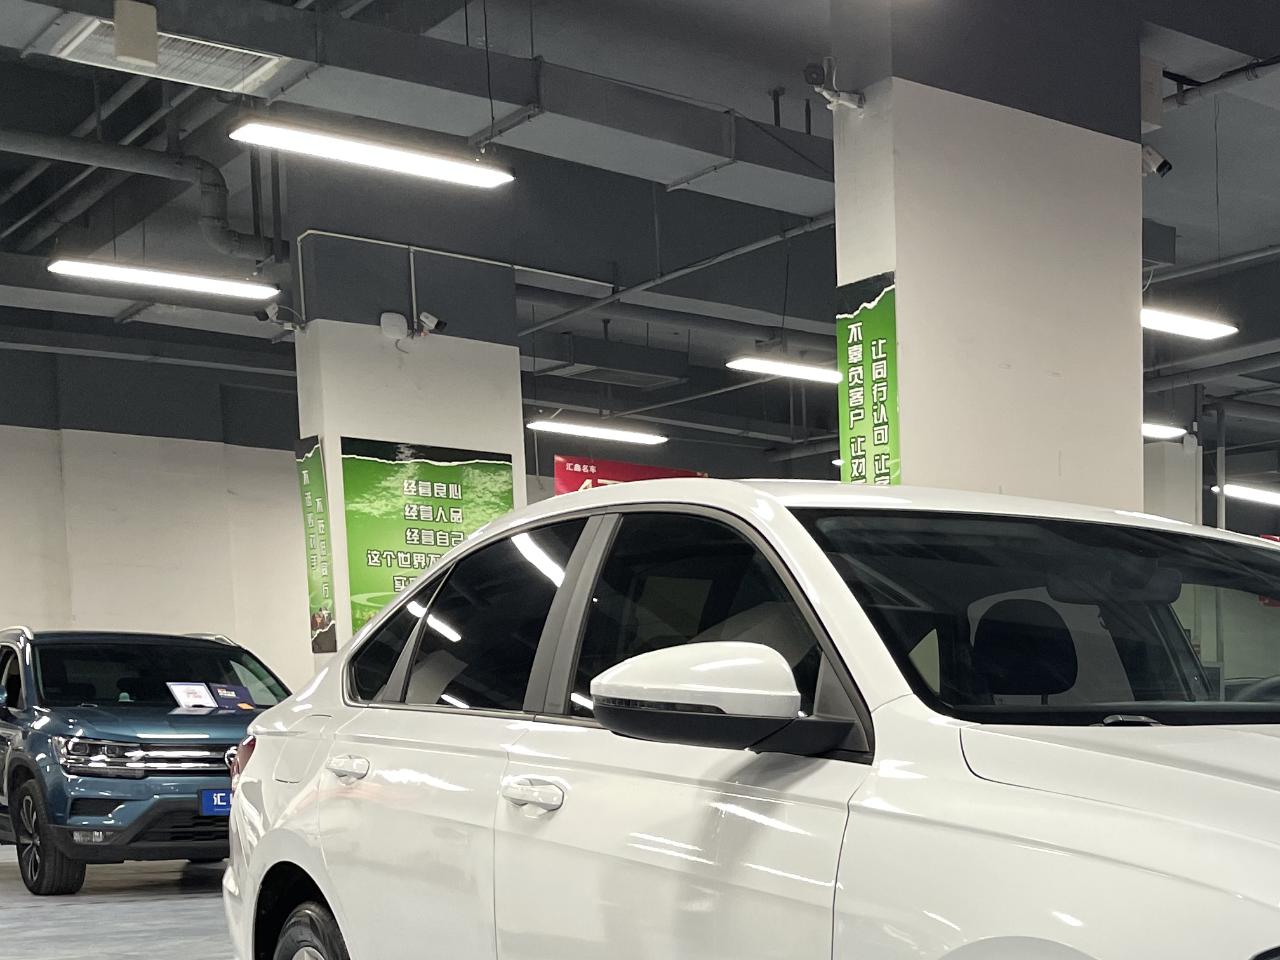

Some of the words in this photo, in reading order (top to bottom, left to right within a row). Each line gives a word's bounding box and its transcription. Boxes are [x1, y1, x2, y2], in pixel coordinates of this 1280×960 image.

[565, 463, 597, 474] 汇鑫名车
[403, 479, 462, 499] 经营良心
[404, 504, 463, 523] 经营人品
[405, 528, 465, 547] 经营自己
